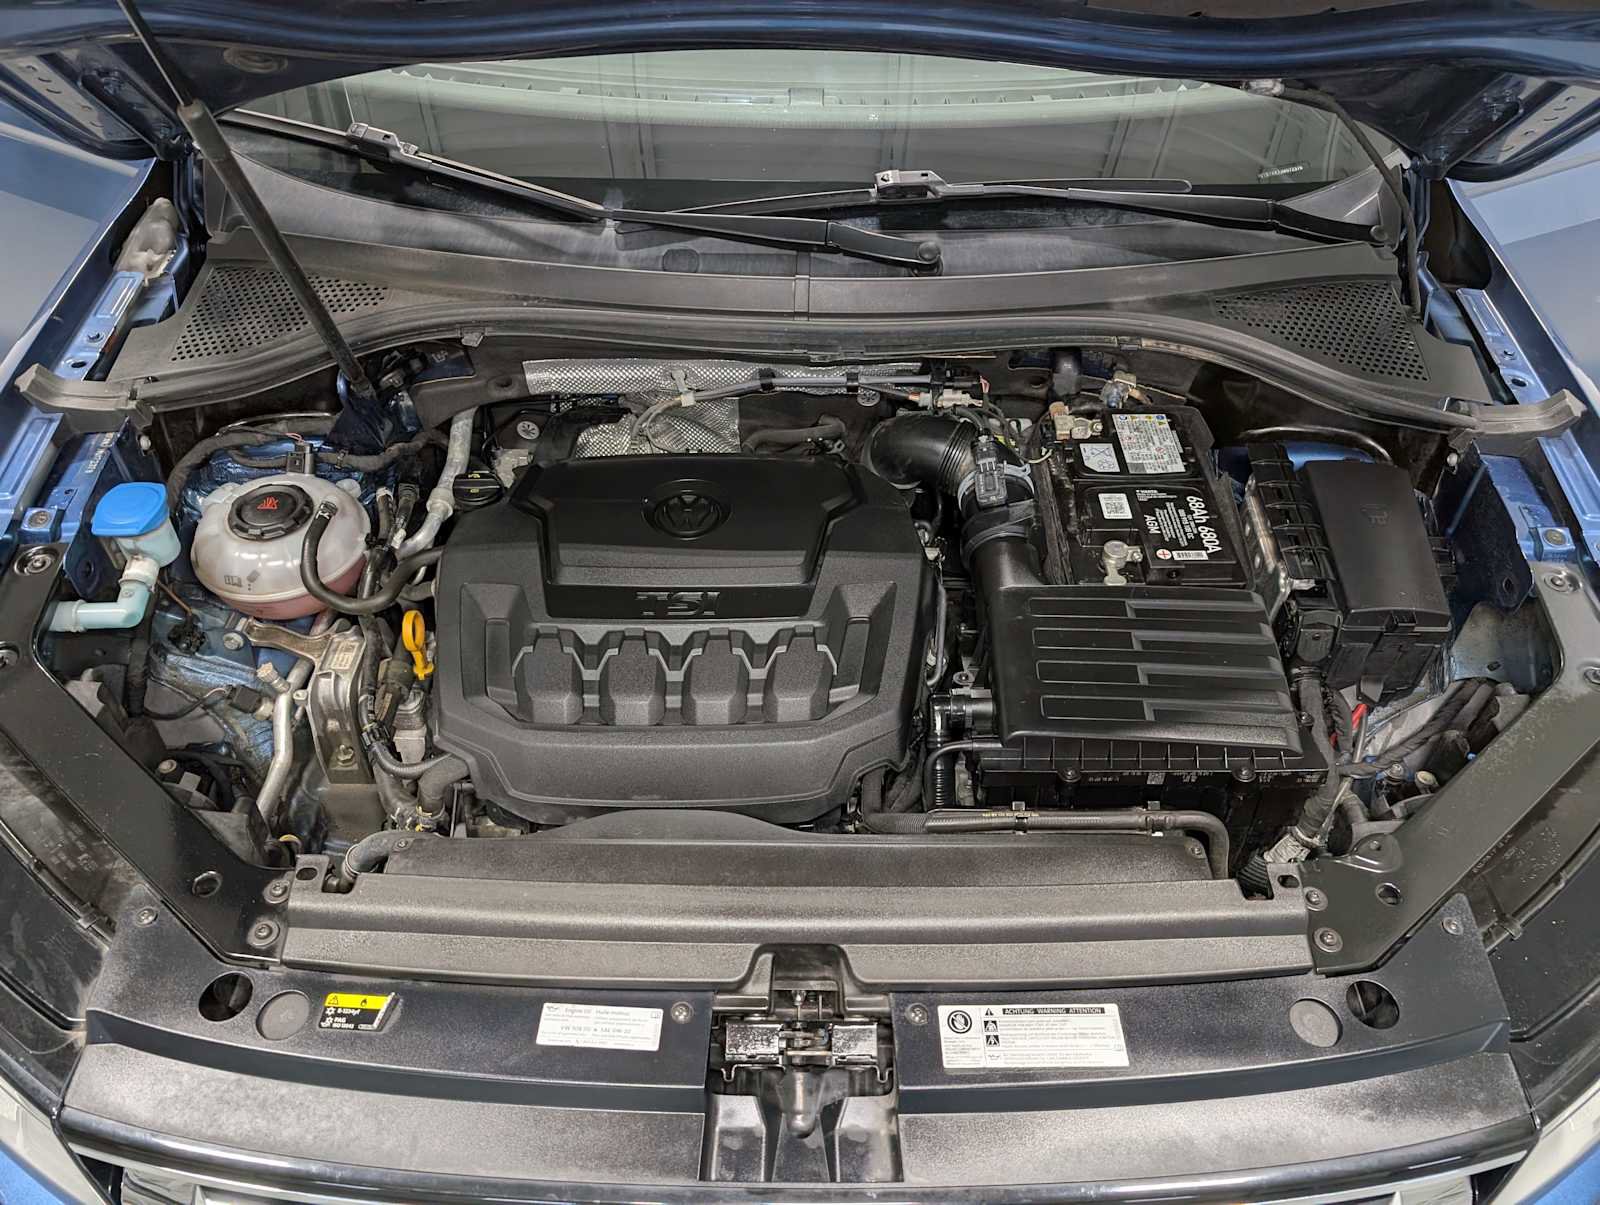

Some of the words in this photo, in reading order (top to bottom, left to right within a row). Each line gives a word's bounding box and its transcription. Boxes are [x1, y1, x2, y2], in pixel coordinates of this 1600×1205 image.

[1144, 514, 1161, 534] AGM
[1186, 495, 1210, 524] 68Ah
[1198, 525, 1222, 554] 680A
[636, 591, 720, 616] TSI
